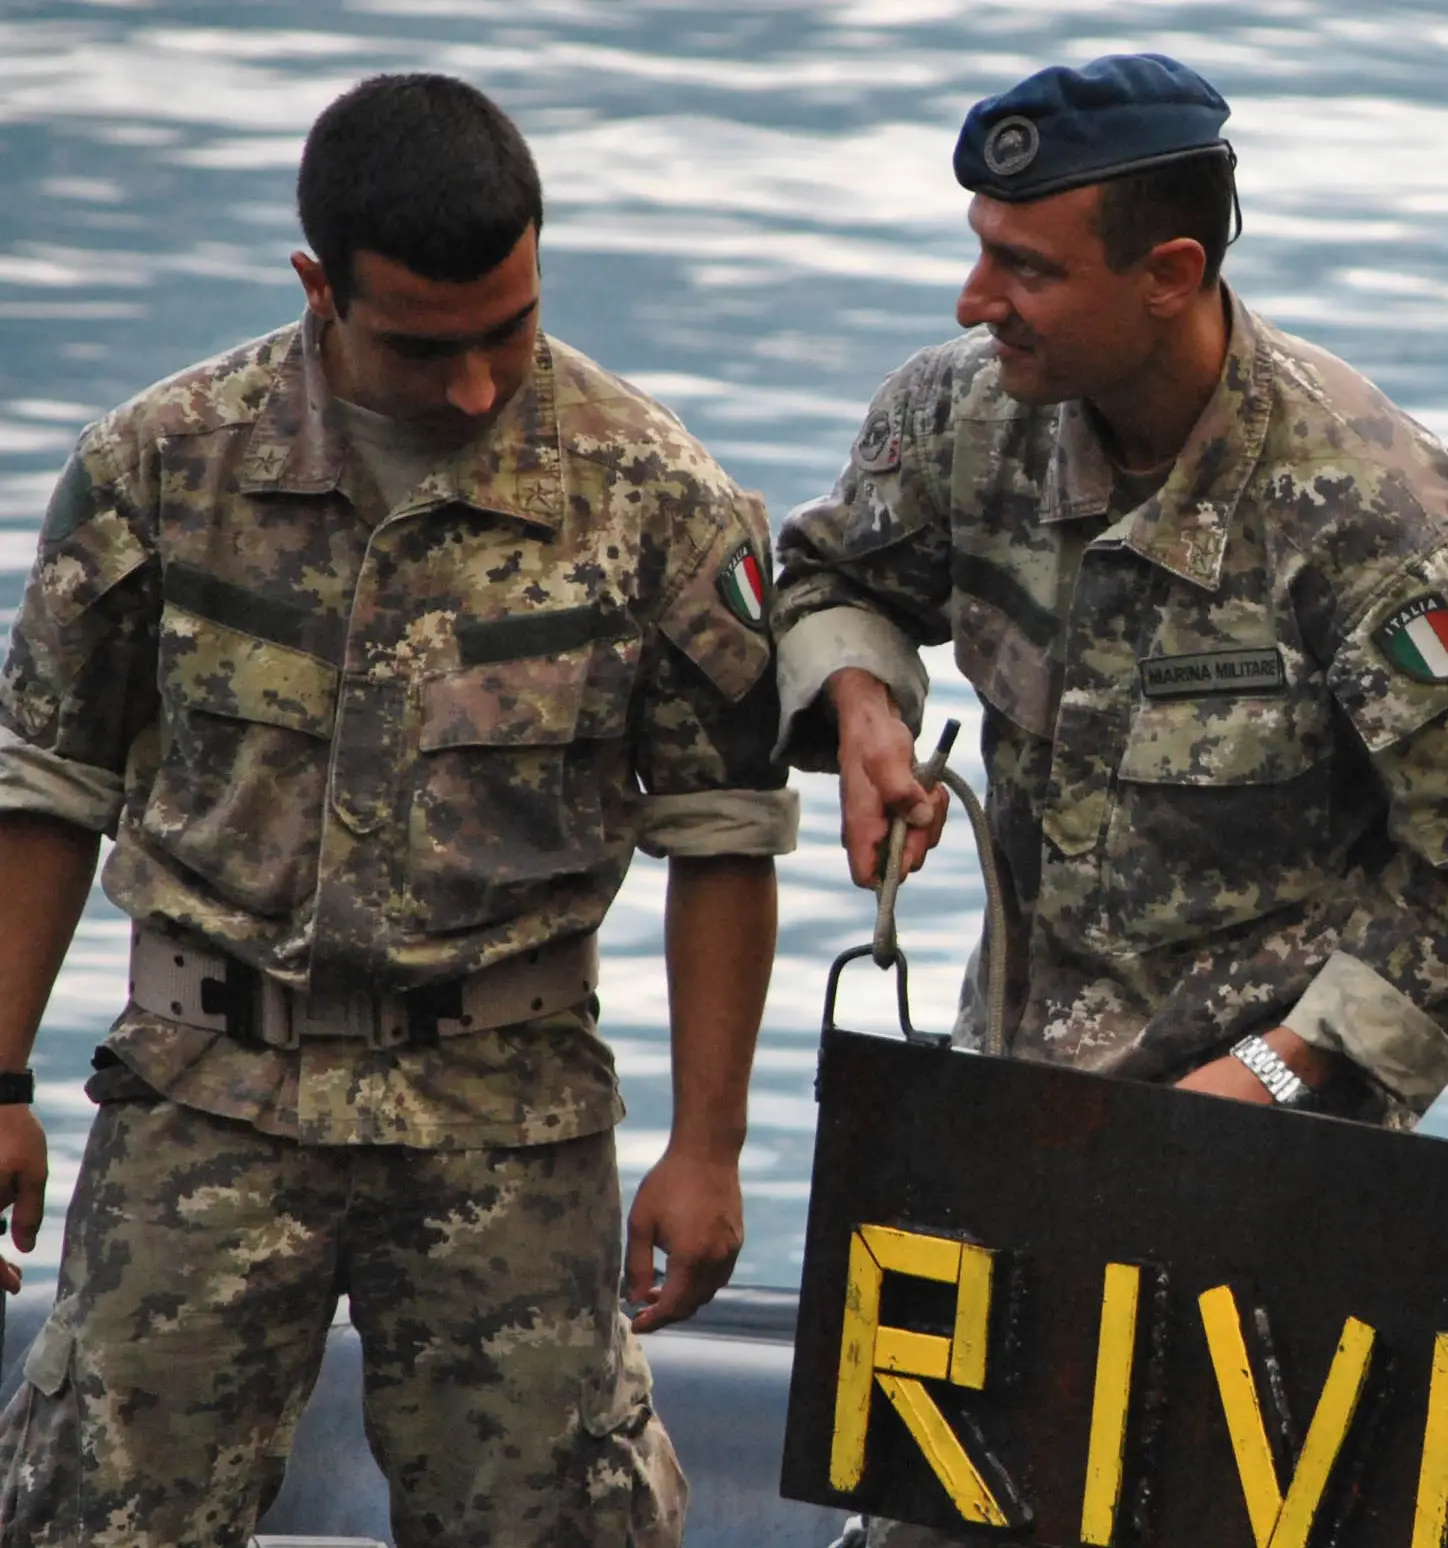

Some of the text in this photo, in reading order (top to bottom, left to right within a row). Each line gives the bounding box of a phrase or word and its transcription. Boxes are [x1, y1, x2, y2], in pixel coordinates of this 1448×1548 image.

[1385, 598, 1438, 636] ITALIA
[1149, 660, 1275, 686] MARINA MILITARE
